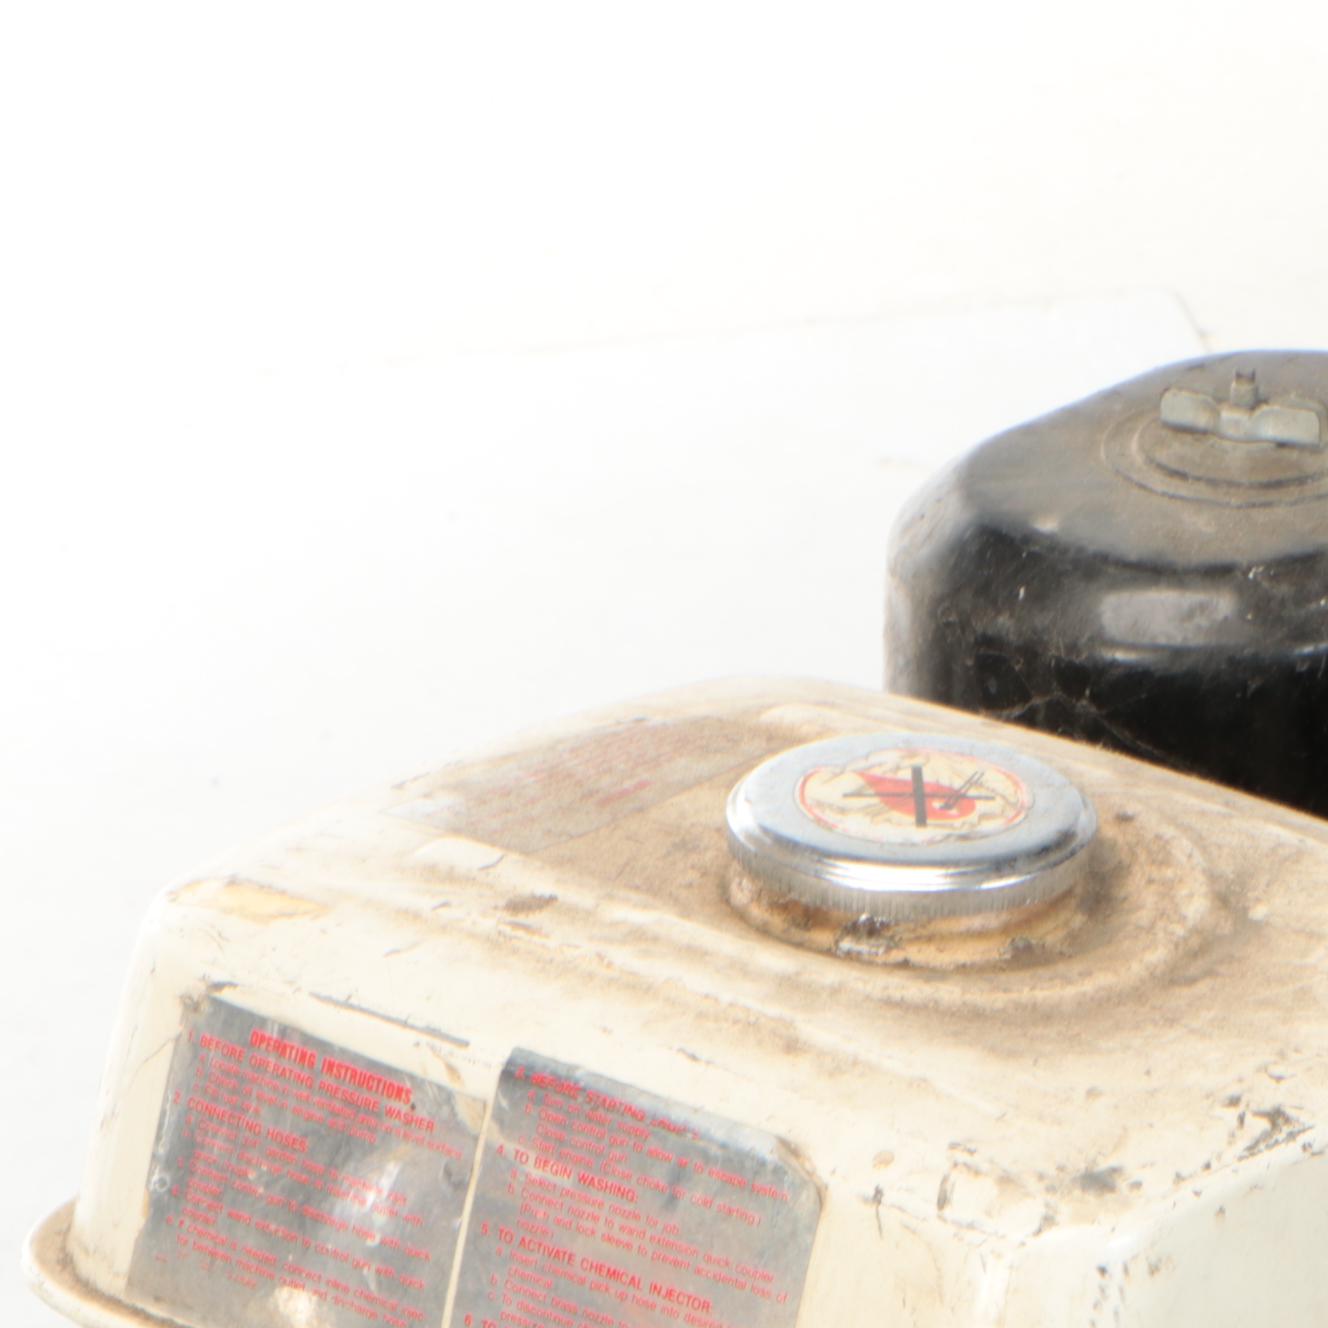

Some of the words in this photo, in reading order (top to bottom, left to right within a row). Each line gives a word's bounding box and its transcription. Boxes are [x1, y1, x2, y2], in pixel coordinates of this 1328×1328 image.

[198, 1033, 245, 1062] BEFORE
[248, 1051, 315, 1088] OPERATING
[317, 1077, 380, 1113] PRESSURE
[248, 1027, 318, 1070] OPERATING
[320, 1054, 413, 1106] INSTRUCTIONS
[186, 1094, 263, 1135] CONNECTING
[512, 1147, 530, 1166] TO
[533, 1154, 574, 1181] BEGIN
[495, 1227, 515, 1248] TO
[516, 1234, 576, 1269] ACTIVATE
[578, 1255, 645, 1292] CHEMICAL
